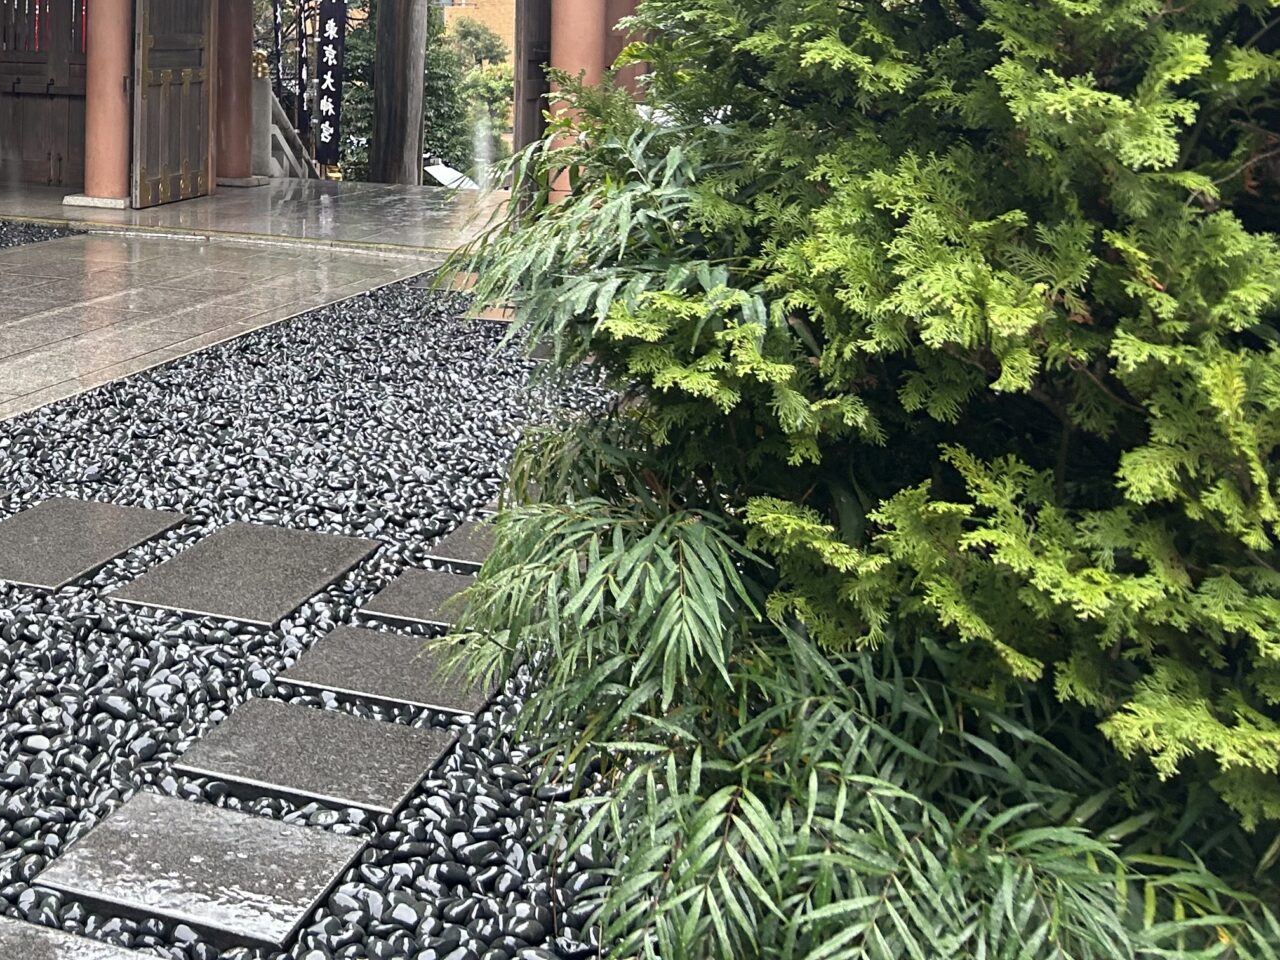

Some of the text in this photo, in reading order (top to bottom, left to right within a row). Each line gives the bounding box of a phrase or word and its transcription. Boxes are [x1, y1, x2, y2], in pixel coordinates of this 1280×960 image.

[319, 18, 339, 143] 東京大神宮
